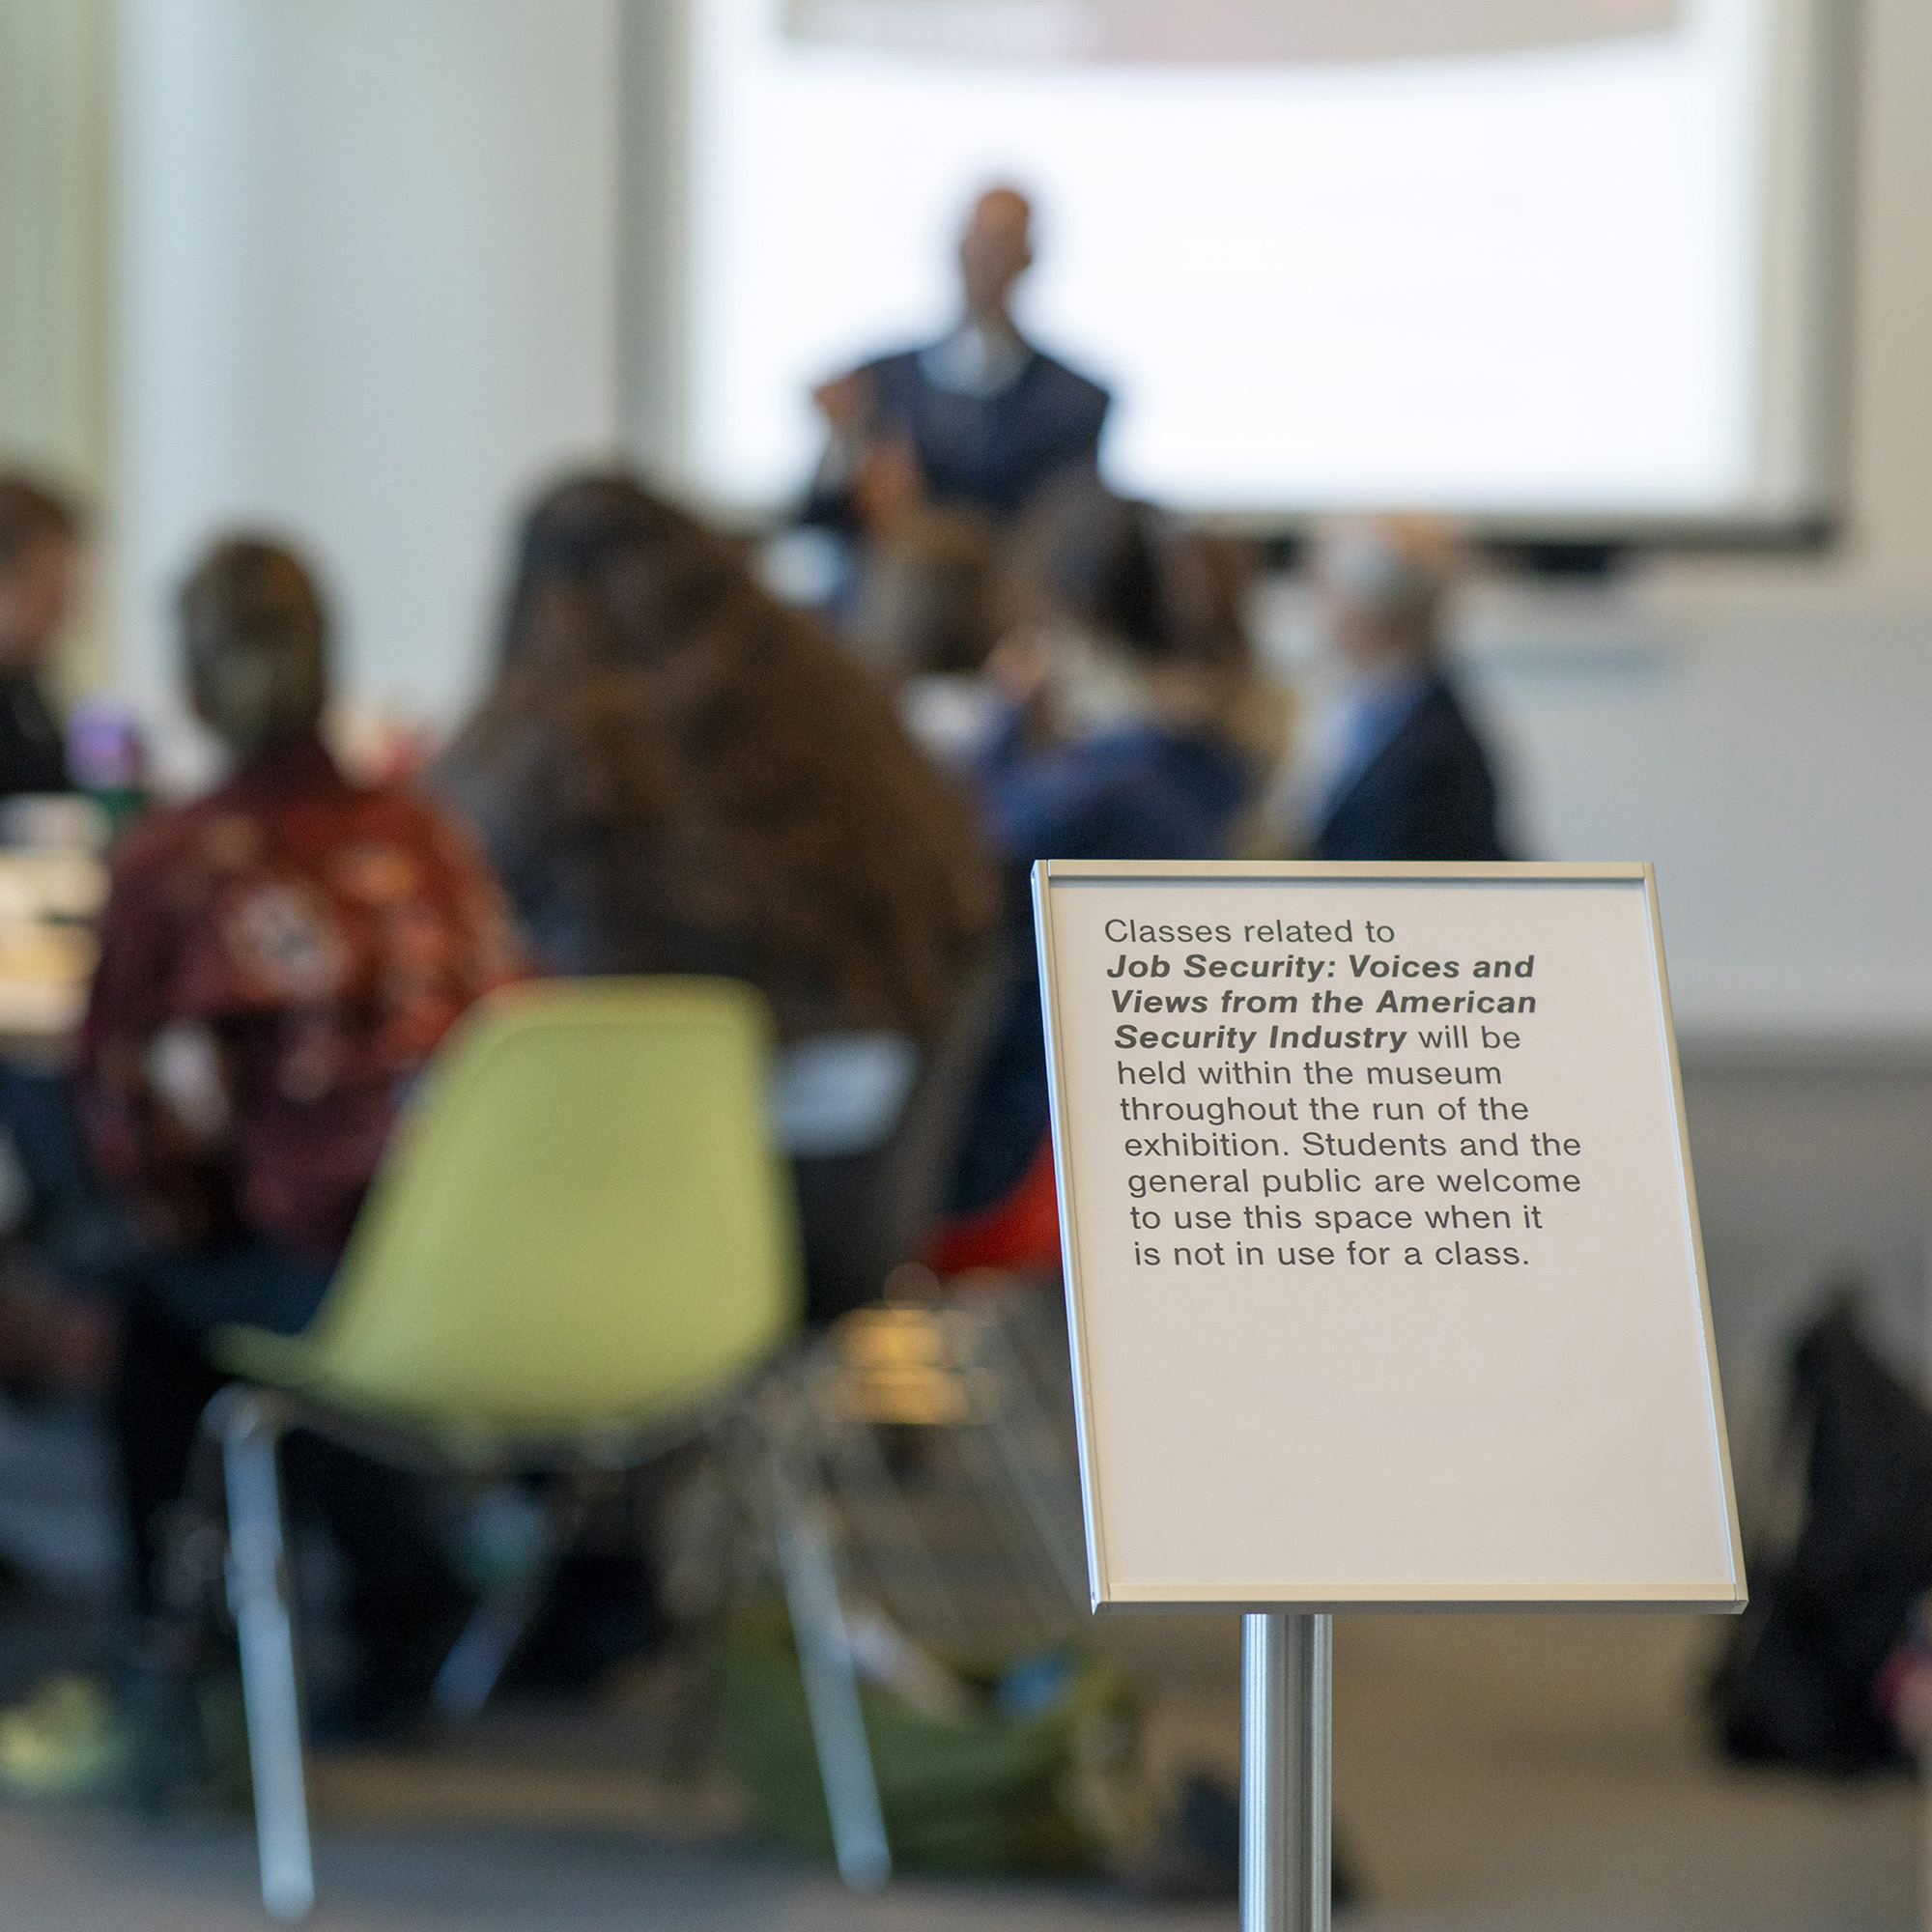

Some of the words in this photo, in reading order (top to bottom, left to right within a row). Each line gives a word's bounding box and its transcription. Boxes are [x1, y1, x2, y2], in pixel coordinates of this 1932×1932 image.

[1105, 919, 1231, 943] Classes
[1244, 920, 1352, 942] related
[1365, 921, 1394, 943] to
[1107, 954, 1170, 978] Job
[1184, 954, 1335, 982] Security:
[1350, 954, 1459, 978] Voices
[1473, 955, 1534, 978] and
[1112, 990, 1208, 1013] Views
[1222, 990, 1297, 1013] from
[1312, 990, 1363, 1013] the
[1376, 990, 1536, 1013] American
[1115, 1025, 1257, 1053] Security
[1269, 1025, 1407, 1053] Industry
[1418, 1025, 1467, 1048] will
[1481, 1026, 1520, 1049] be
[1118, 1061, 1185, 1085] held
[1198, 1061, 1291, 1084] within
[1303, 1061, 1352, 1084] the
[1367, 1066, 1501, 1085] museum
[1120, 1096, 1298, 1125] throughout
[1309, 1097, 1359, 1120] the
[1373, 1103, 1424, 1120] run
[1438, 1096, 1466, 1121] of
[1478, 1096, 1528, 1121] the
[1125, 1132, 1288, 1156] exhibition.
[1303, 1132, 1446, 1156] Students
[1461, 1132, 1518, 1156] and
[1530, 1132, 1580, 1156] the
[1128, 1169, 1248, 1198] general
[1263, 1169, 1361, 1197] public
[1376, 1175, 1424, 1192] are
[1436, 1169, 1580, 1192] welcome
[1130, 1207, 1160, 1229] to
[1175, 1211, 1231, 1229] use
[1243, 1205, 1301, 1229] this
[1316, 1211, 1412, 1234] space
[1425, 1205, 1511, 1229] when
[1523, 1205, 1543, 1229] it
[1135, 1241, 1160, 1265] is
[1175, 1242, 1225, 1265] not
[1236, 1241, 1264, 1264] in
[1278, 1247, 1334, 1265] use
[1347, 1240, 1390, 1265] for
[1405, 1247, 1423, 1264] a
[1435, 1241, 1528, 1264] class.
